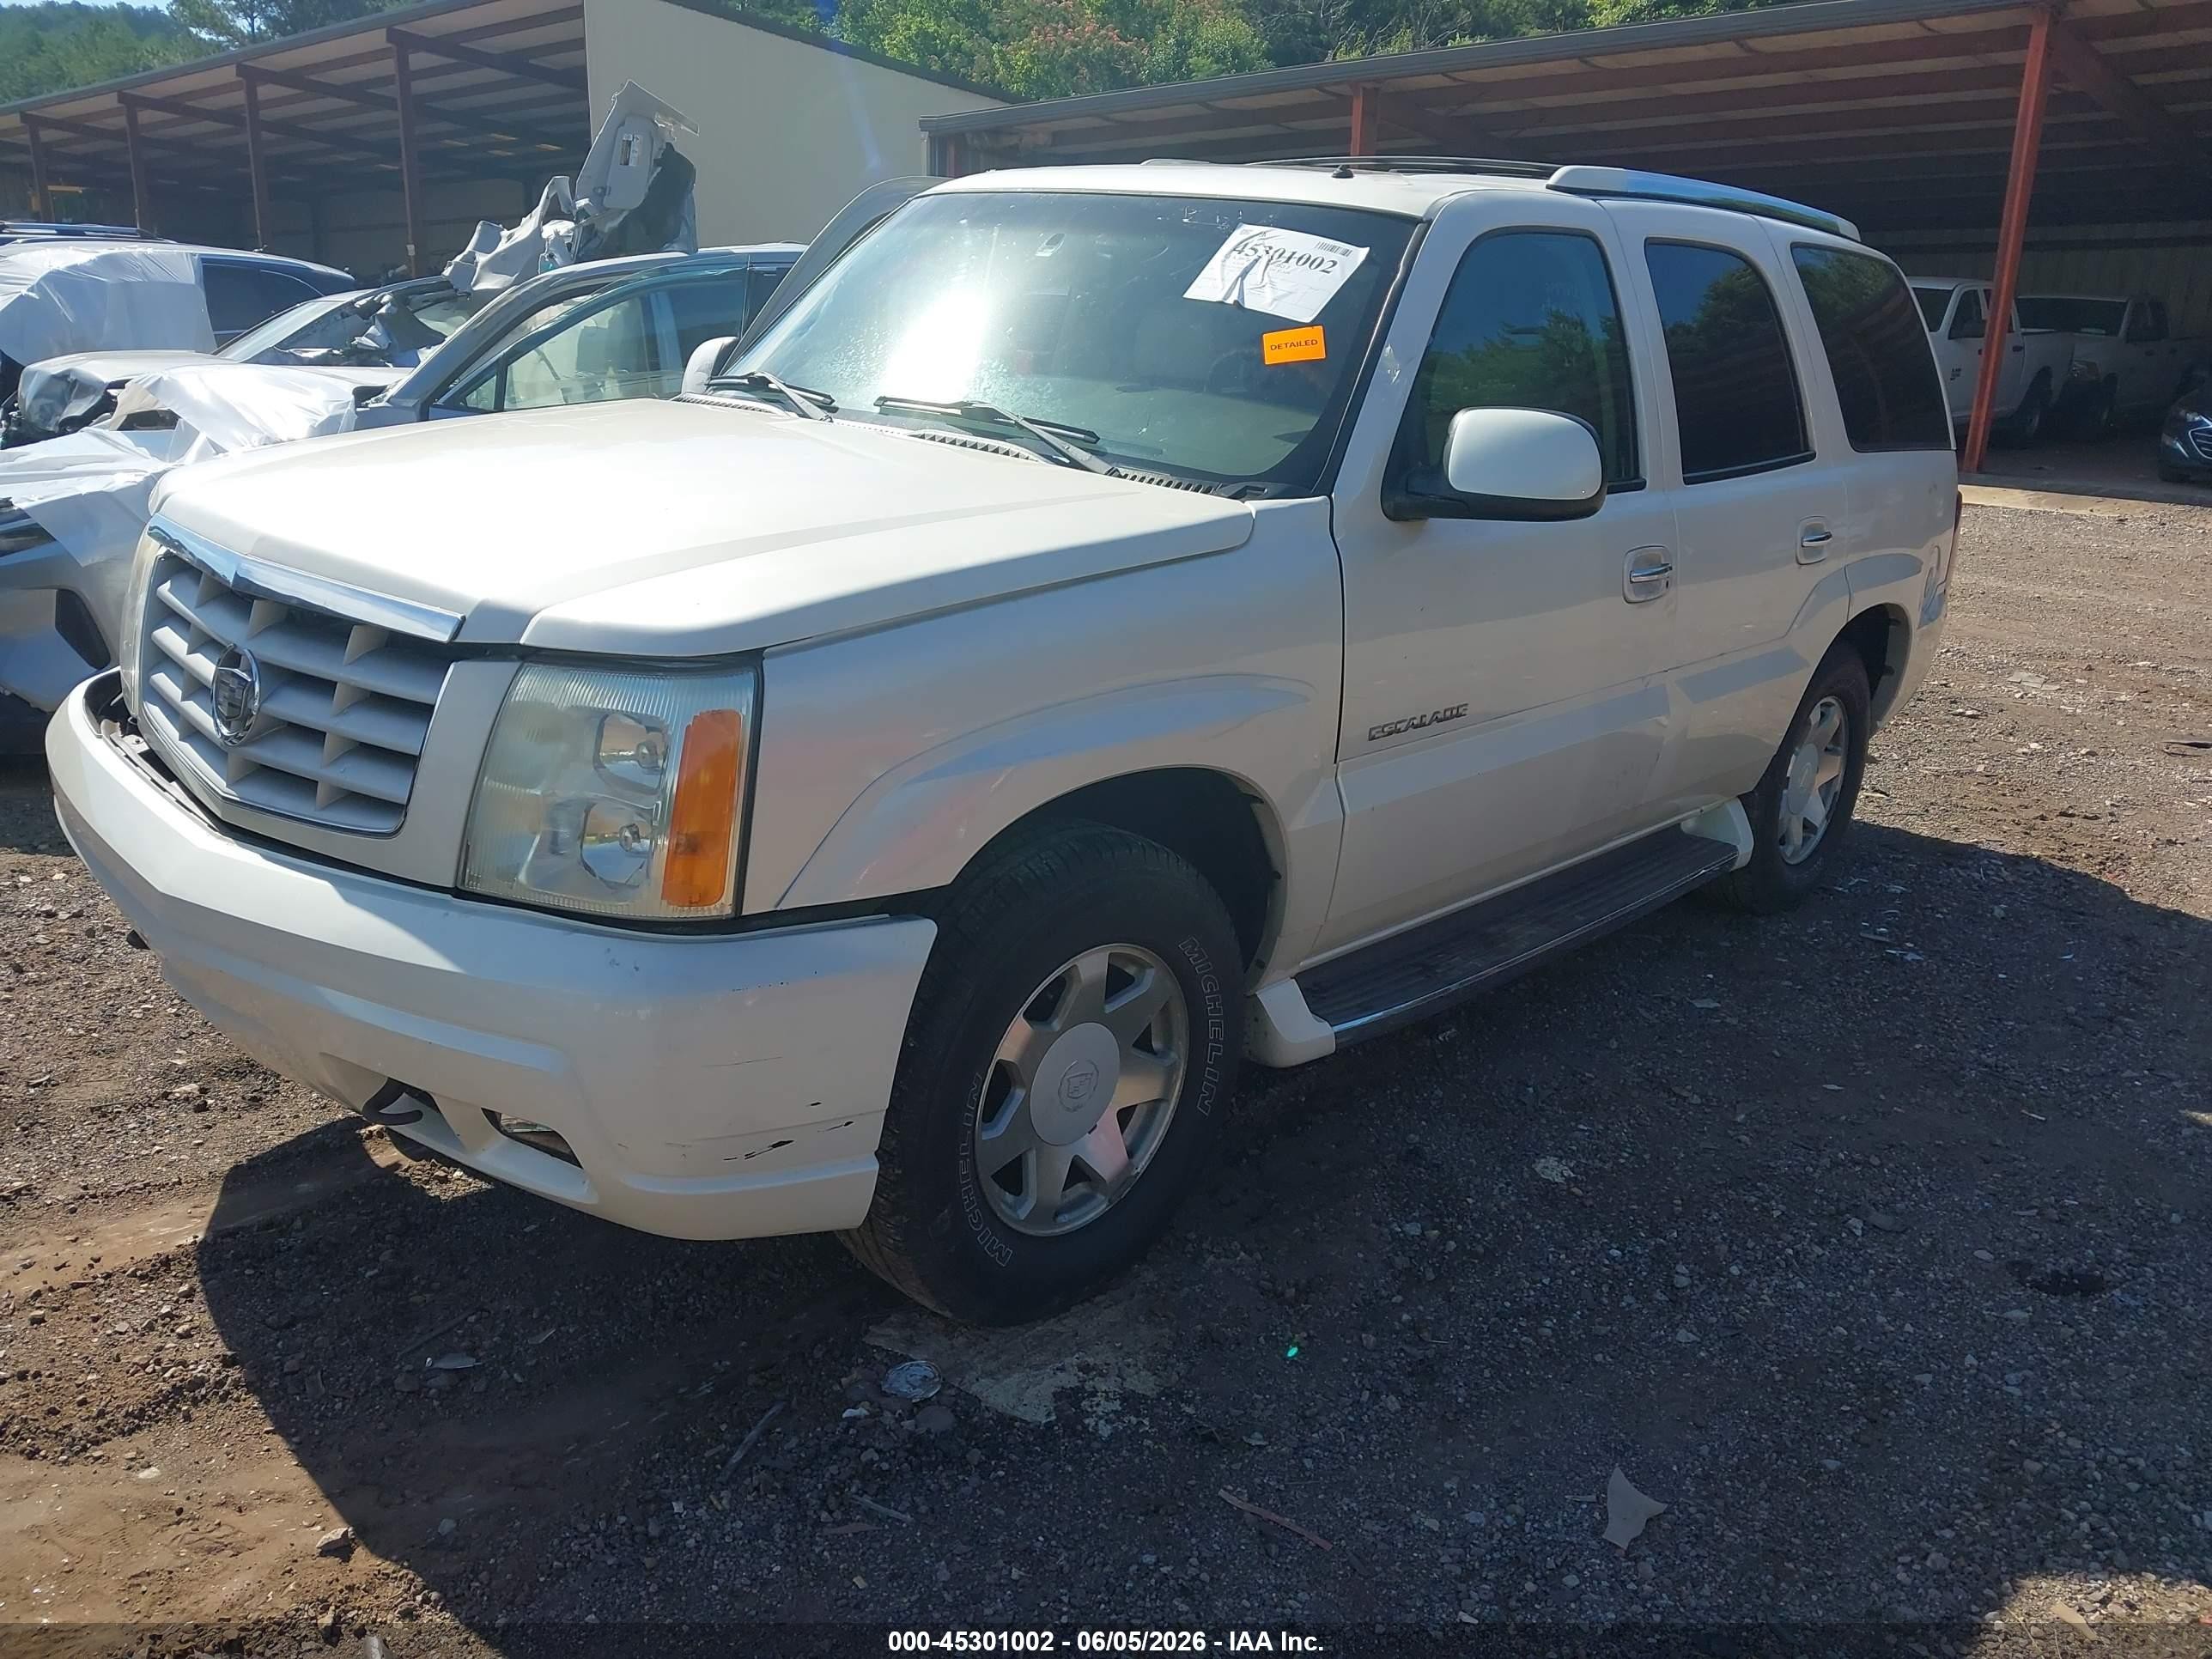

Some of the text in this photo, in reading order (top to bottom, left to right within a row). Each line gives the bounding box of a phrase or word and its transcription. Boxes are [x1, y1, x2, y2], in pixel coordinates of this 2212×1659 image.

[1270, 339, 1318, 350] DETAILED
[1368, 702, 1469, 741] ESCALADE
[1178, 933, 1224, 1116] MICHELIN
[958, 1073, 1013, 1267] MICHELIN
